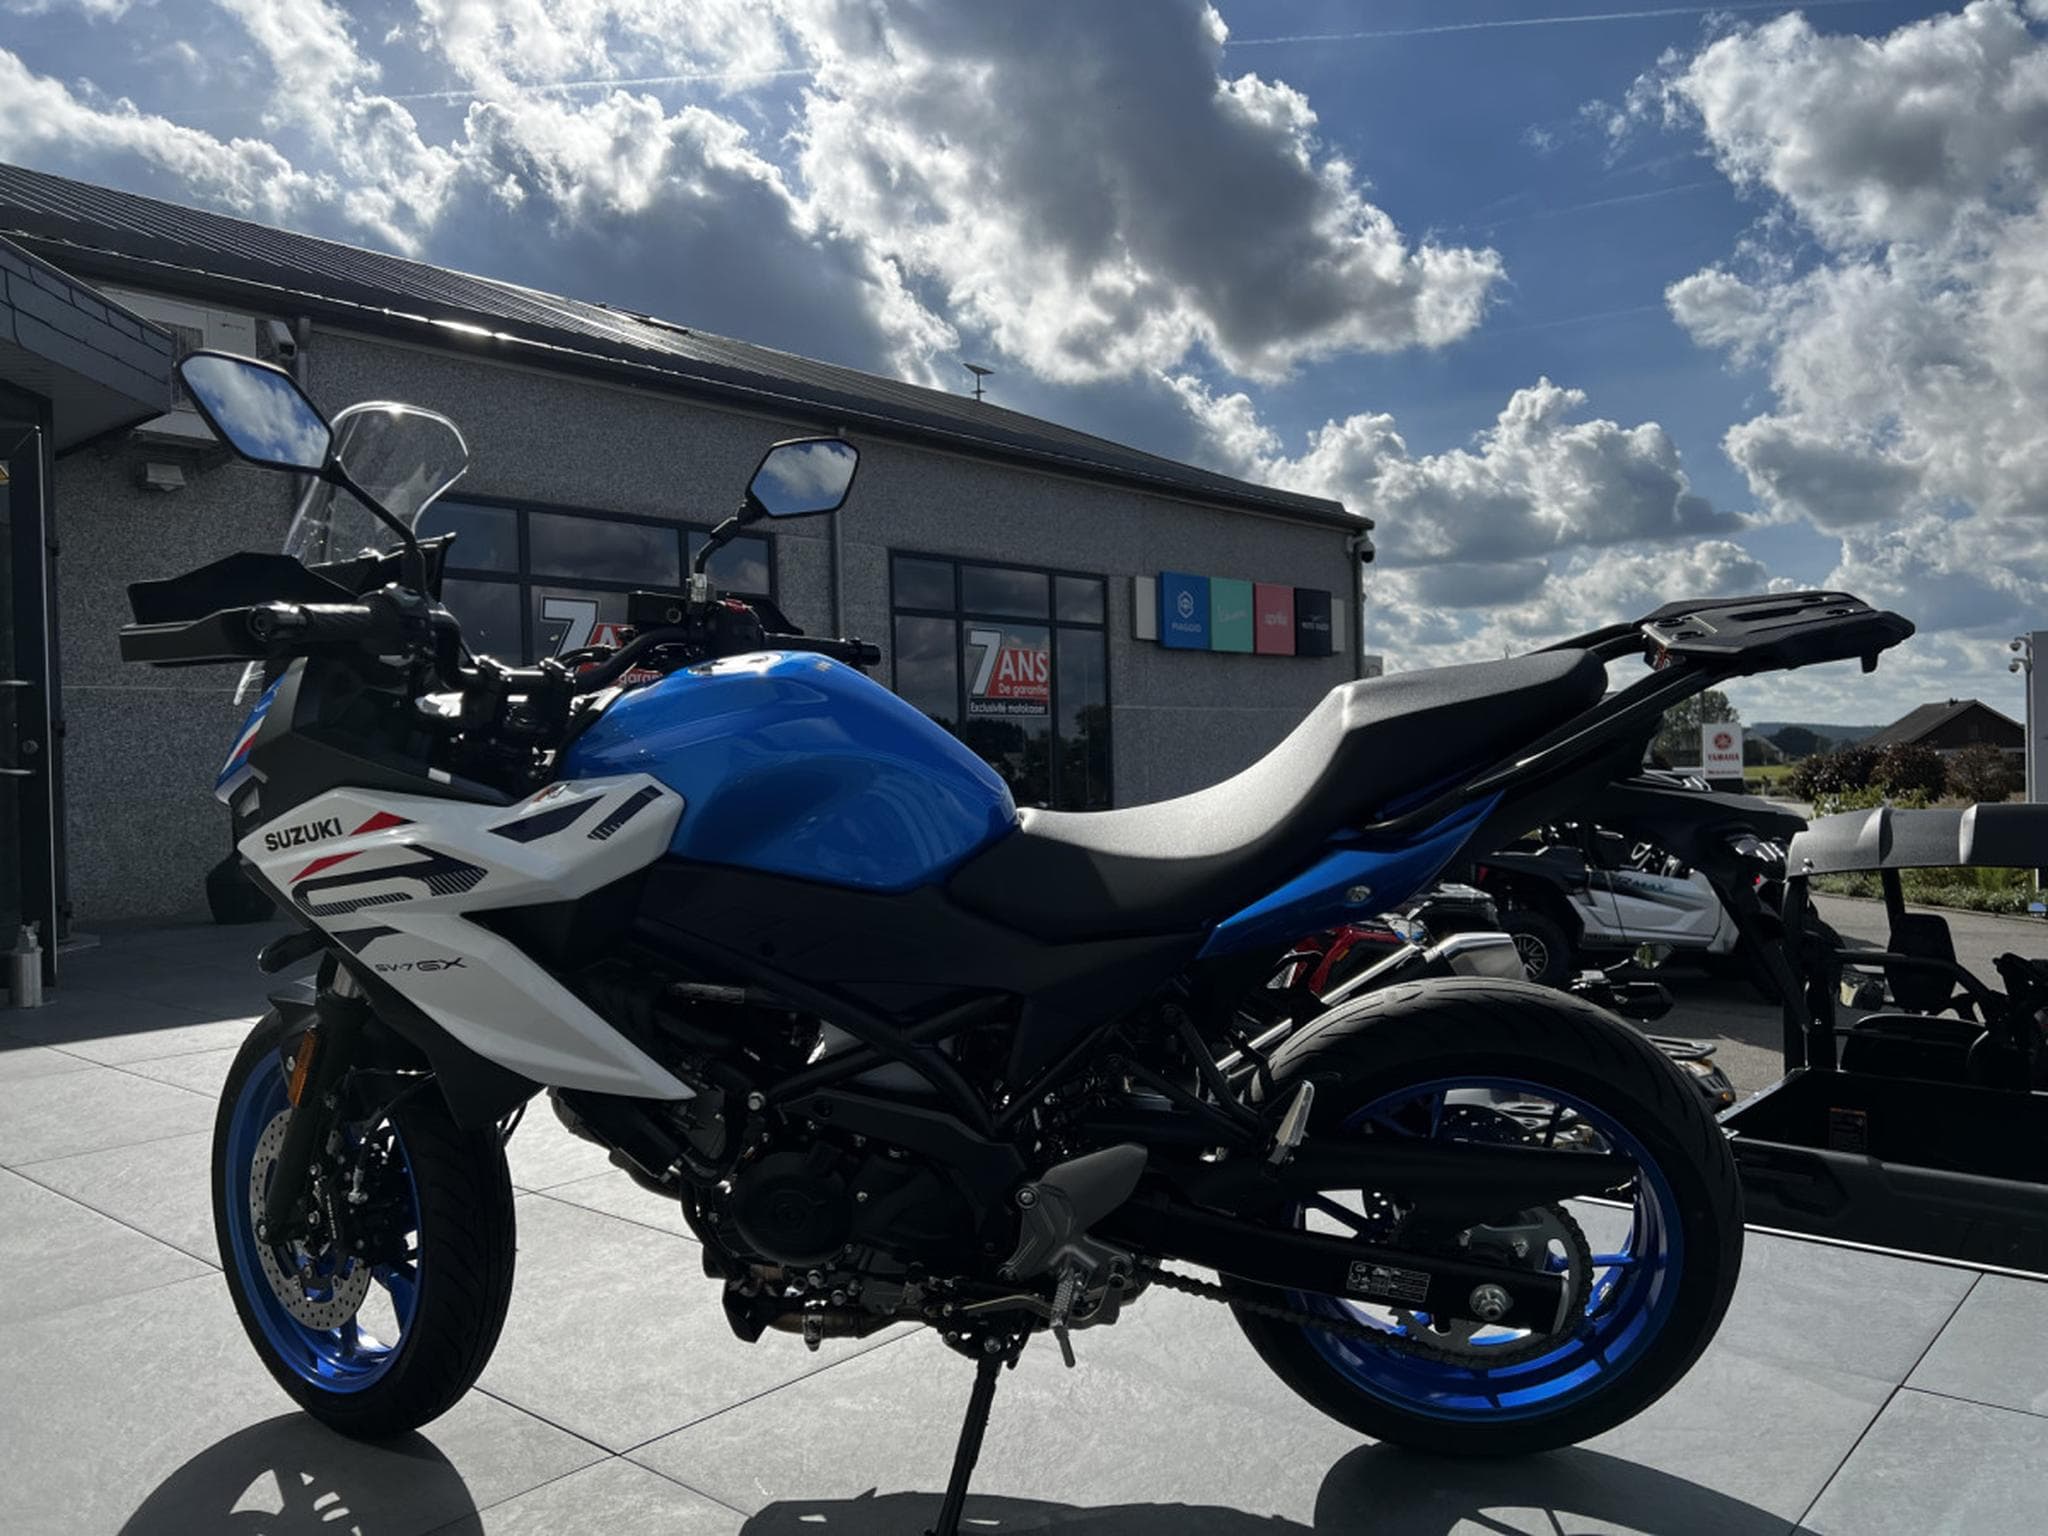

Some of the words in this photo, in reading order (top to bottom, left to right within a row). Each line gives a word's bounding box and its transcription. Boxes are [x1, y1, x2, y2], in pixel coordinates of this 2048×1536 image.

[542, 596, 598, 658] 7
[968, 630, 1001, 696] 7
[998, 649, 1048, 683] ANS
[1707, 753, 1740, 761] YAMAHA
[264, 817, 342, 851] SUZUKI
